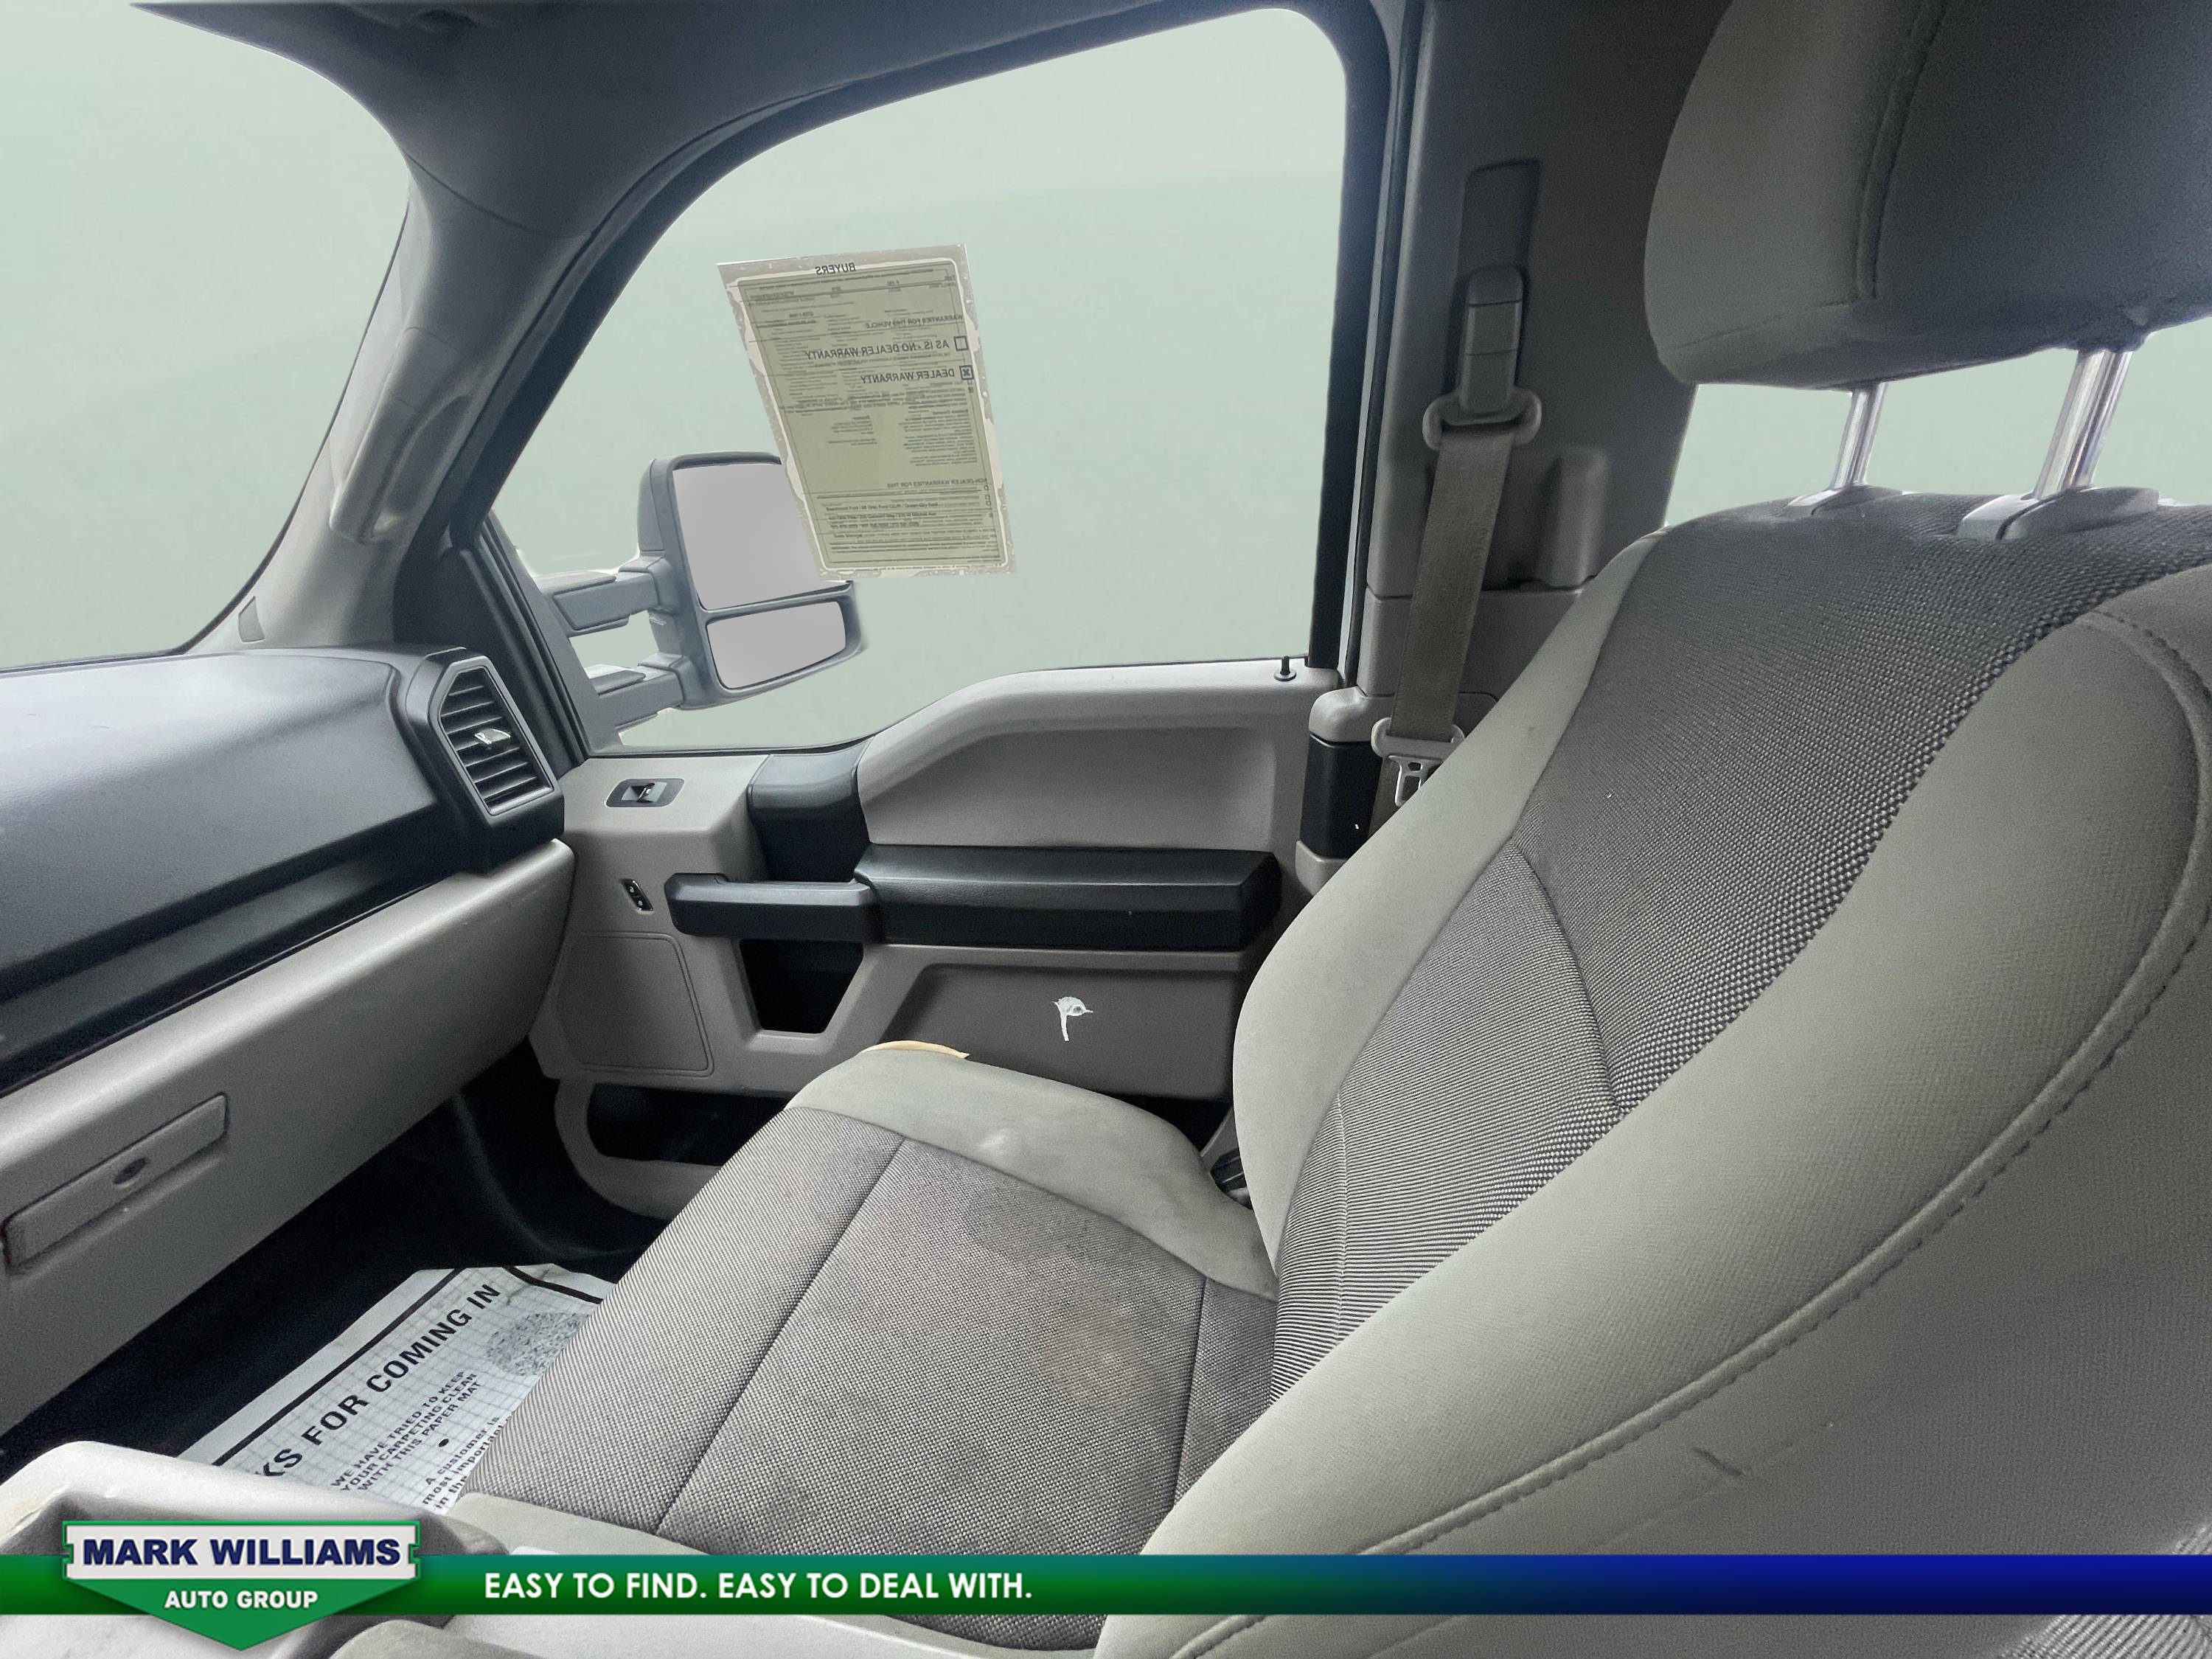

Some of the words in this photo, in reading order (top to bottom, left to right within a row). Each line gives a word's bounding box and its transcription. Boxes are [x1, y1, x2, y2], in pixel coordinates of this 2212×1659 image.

[301, 1394, 371, 1446] FOR
[366, 1309, 473, 1393] COMING
[466, 1284, 501, 1310] IN
[331, 1469, 355, 1487] WE
[354, 1441, 388, 1469] HAVE
[387, 1411, 422, 1439] TRIED
[422, 1396, 439, 1409] TO
[438, 1371, 465, 1395] KEEP
[341, 1462, 378, 1492] YOUR
[378, 1405, 442, 1461] CARPETING
[442, 1374, 477, 1404] CLEAN
[357, 1462, 394, 1492] WITH
[392, 1438, 422, 1461] THIS
[422, 1403, 459, 1437] PAPER
[457, 1381, 482, 1402] MAT
[425, 1478, 437, 1486] A
[437, 1429, 487, 1475] customer
[422, 1476, 452, 1505] most
[434, 1497, 449, 1509] in
